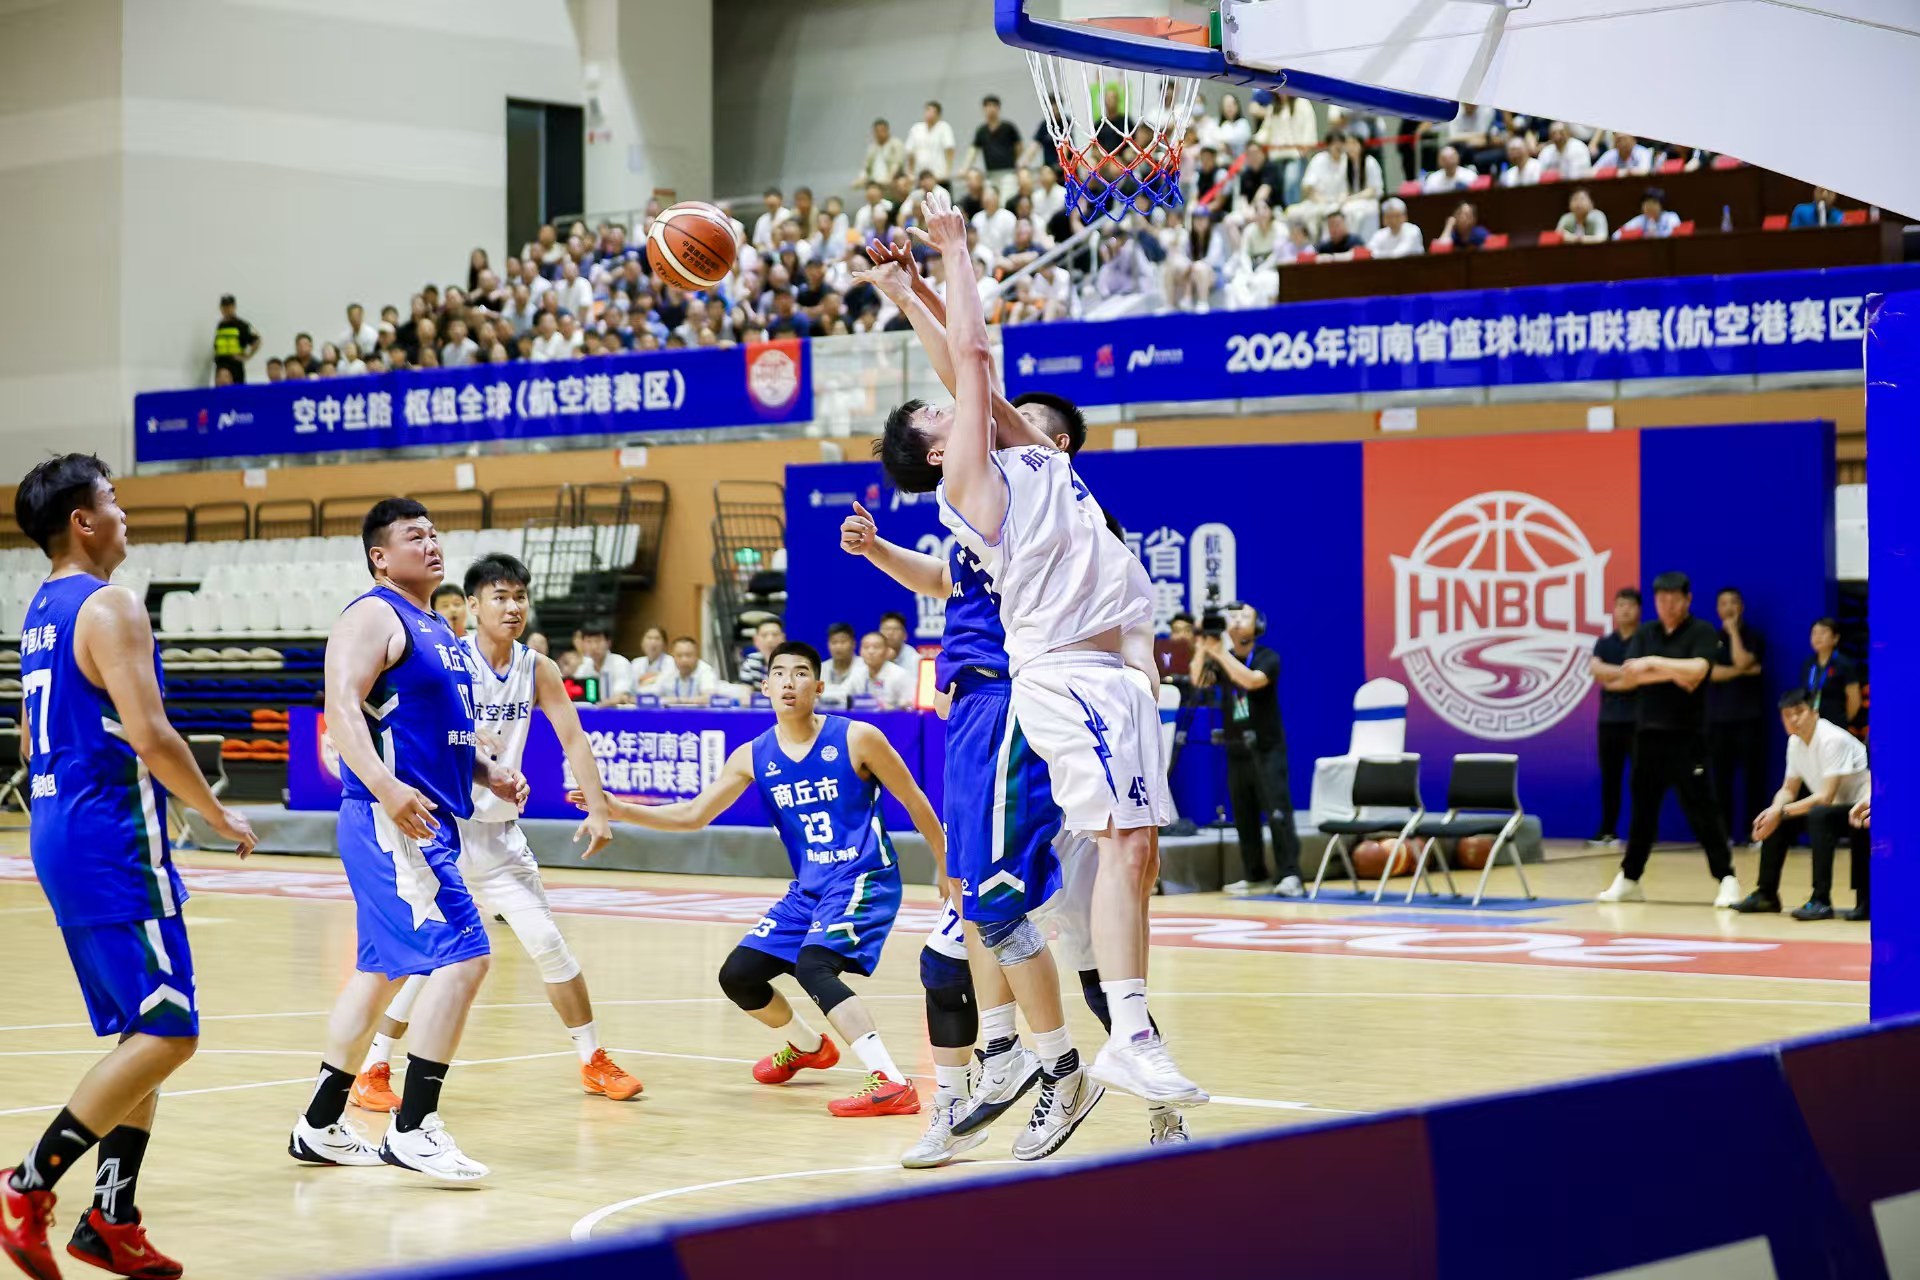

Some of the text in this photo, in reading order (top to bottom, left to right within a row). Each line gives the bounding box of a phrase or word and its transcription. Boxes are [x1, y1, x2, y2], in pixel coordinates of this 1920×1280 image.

[293, 391, 392, 434] 空中丝路
[1408, 570, 1607, 641] HNBCL
[563, 730, 700, 760] 26年河南省
[770, 776, 840, 810] 商丘市
[1127, 776, 1150, 808] 45
[798, 810, 834, 844] 23
